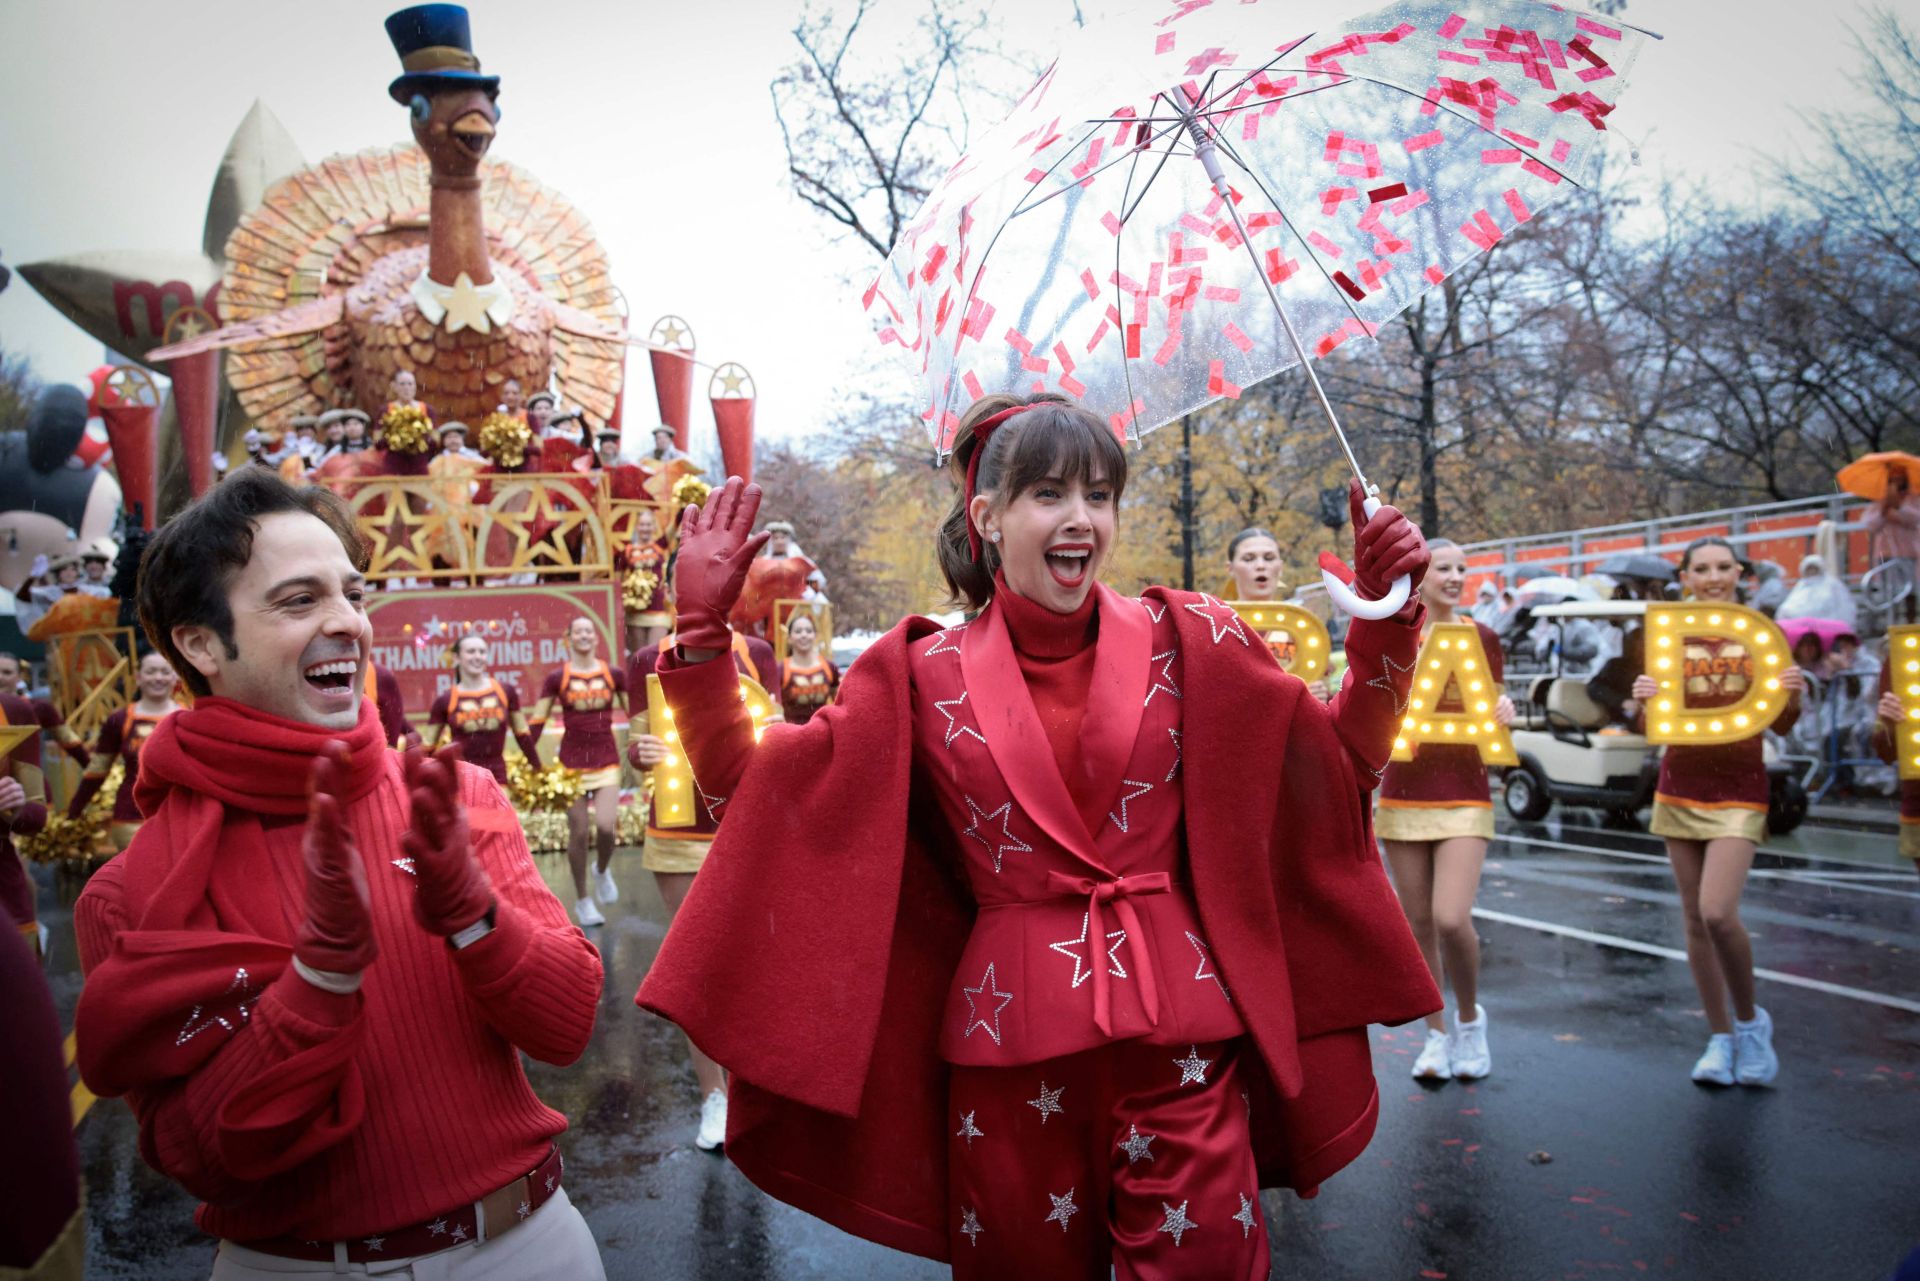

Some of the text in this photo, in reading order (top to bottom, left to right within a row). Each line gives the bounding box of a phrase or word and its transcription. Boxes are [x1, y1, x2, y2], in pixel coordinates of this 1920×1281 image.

[372, 639, 569, 671] THANKVING DA
[1391, 622, 1520, 766] A
[1646, 601, 1792, 745] D
